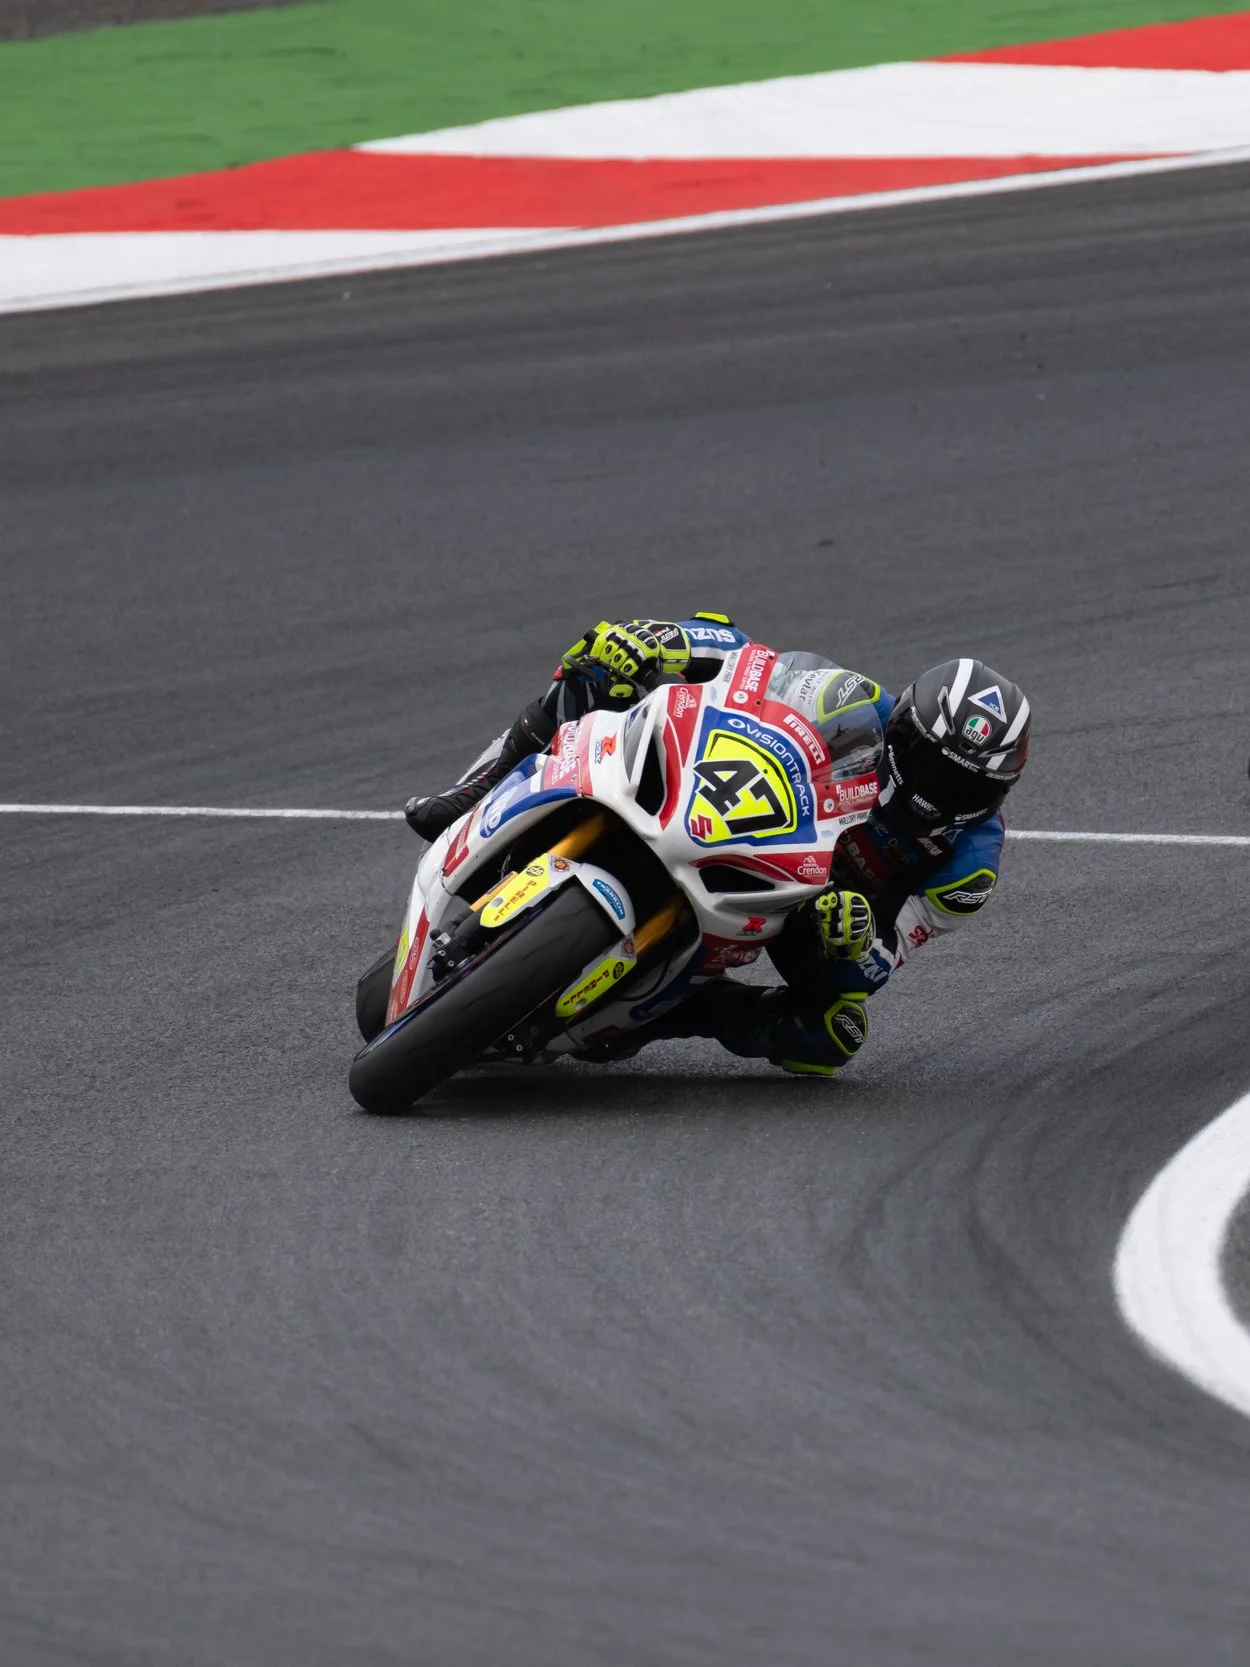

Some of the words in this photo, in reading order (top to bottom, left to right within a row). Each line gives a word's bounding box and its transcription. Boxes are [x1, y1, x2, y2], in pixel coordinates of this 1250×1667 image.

[744, 650, 769, 693] BUILDBASE
[675, 686, 688, 719] Crendon
[835, 675, 865, 709] RST
[783, 713, 826, 766] PIRELLI
[744, 725, 810, 817] VISIONTRACK
[888, 752, 905, 786] Bennetts
[693, 760, 791, 836] 47
[839, 781, 878, 802] BUILDBASE
[797, 864, 827, 876] Crendon
[494, 880, 536, 921] PIRELLI
[563, 968, 610, 1007] PIRELLI
